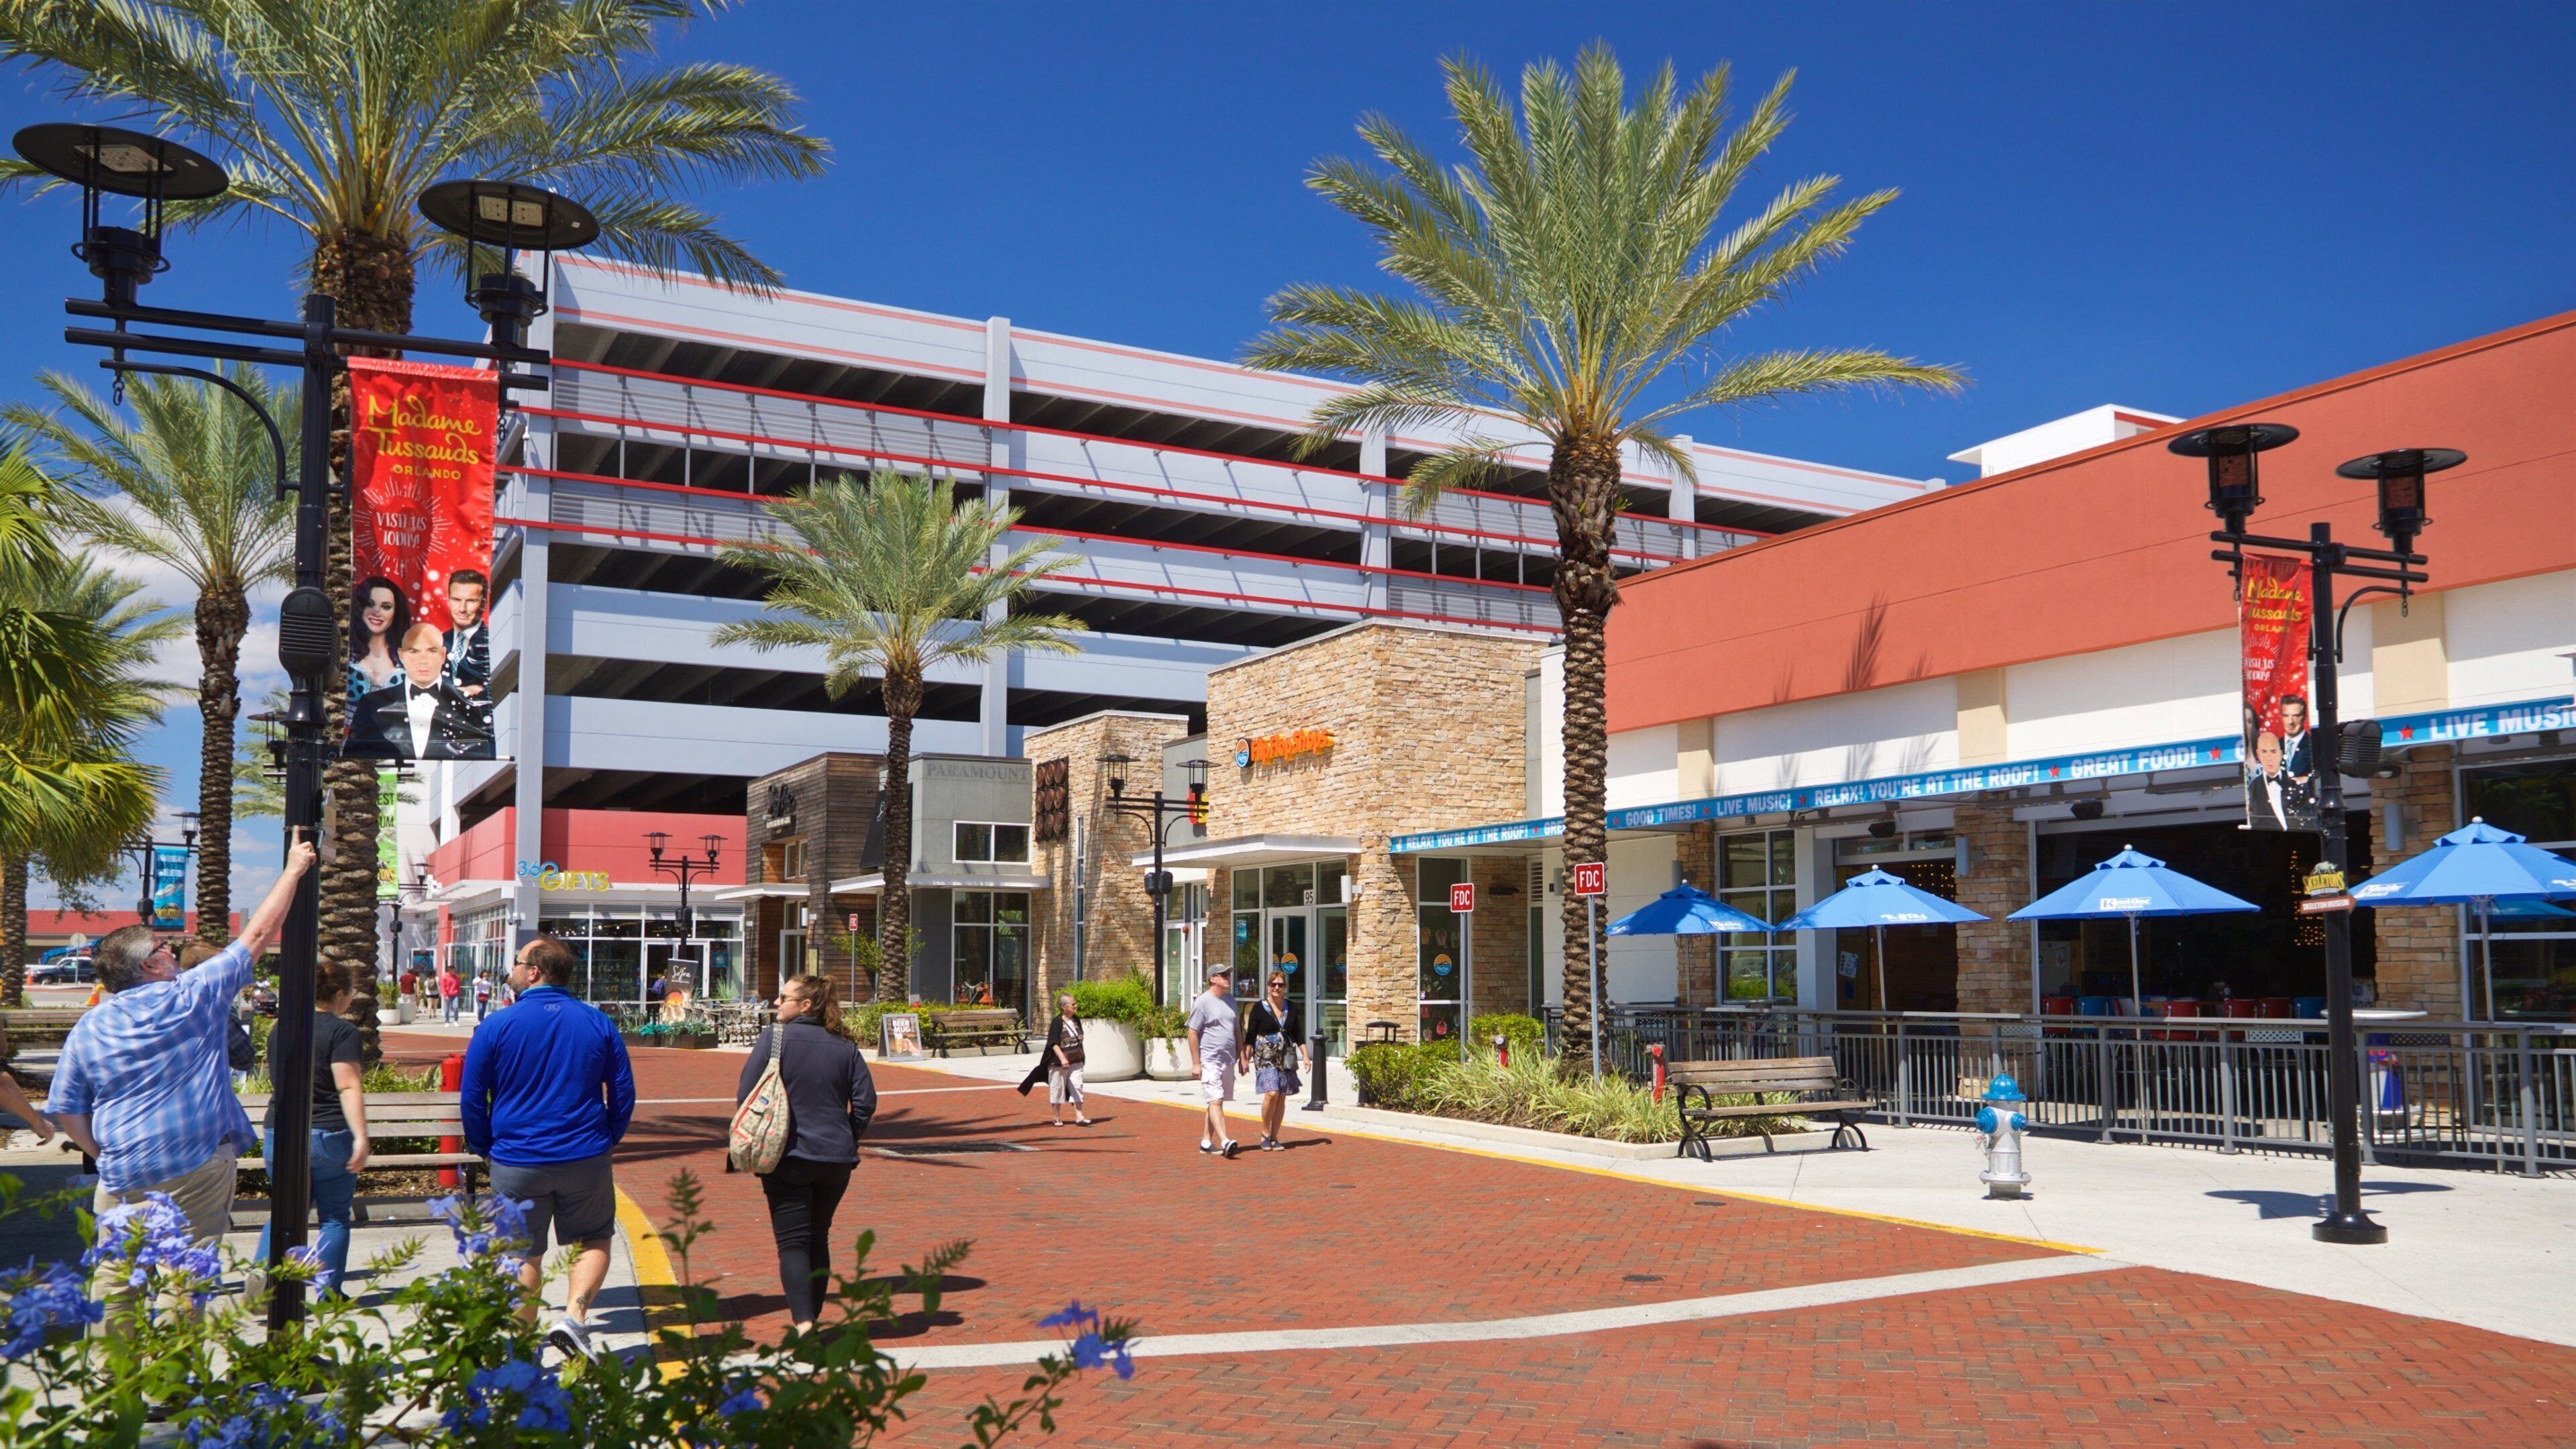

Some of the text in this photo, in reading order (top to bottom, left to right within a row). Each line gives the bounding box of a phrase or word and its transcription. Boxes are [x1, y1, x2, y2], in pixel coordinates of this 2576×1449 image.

[368, 394, 482, 435] Madame
[367, 427, 480, 465] Tussauds
[393, 464, 461, 480] ORLANDO
[376, 512, 427, 531] VISIT US
[382, 531, 420, 548] TODAY!
[2248, 577, 2304, 602] Madame
[2253, 624, 2290, 633] ORLANO
[2430, 704, 2576, 740] LIVE MUSI
[926, 763, 1028, 780] PARAMOUNT
[2071, 746, 2196, 778] GREAT FOOD!
[1815, 765, 2039, 805] RELAX! YOU'RE AT THE ROOF!
[377, 793, 394, 805] EST
[1717, 794, 1791, 816] LIVE MUSIC!
[1626, 805, 1696, 826] GOOD TIMES!
[1544, 820, 1565, 835] GRE
[1407, 825, 1528, 850] RELAX! YOU'RE AT THE ROOF!
[517, 861, 559, 877] 360
[539, 870, 609, 892] GIFTS
[1580, 870, 1599, 888] FDC
[2302, 871, 2345, 894] SKELETONS
[1305, 891, 1313, 904] 95
[1454, 890, 1470, 906] FDC
[672, 965, 692, 981] Sofra
